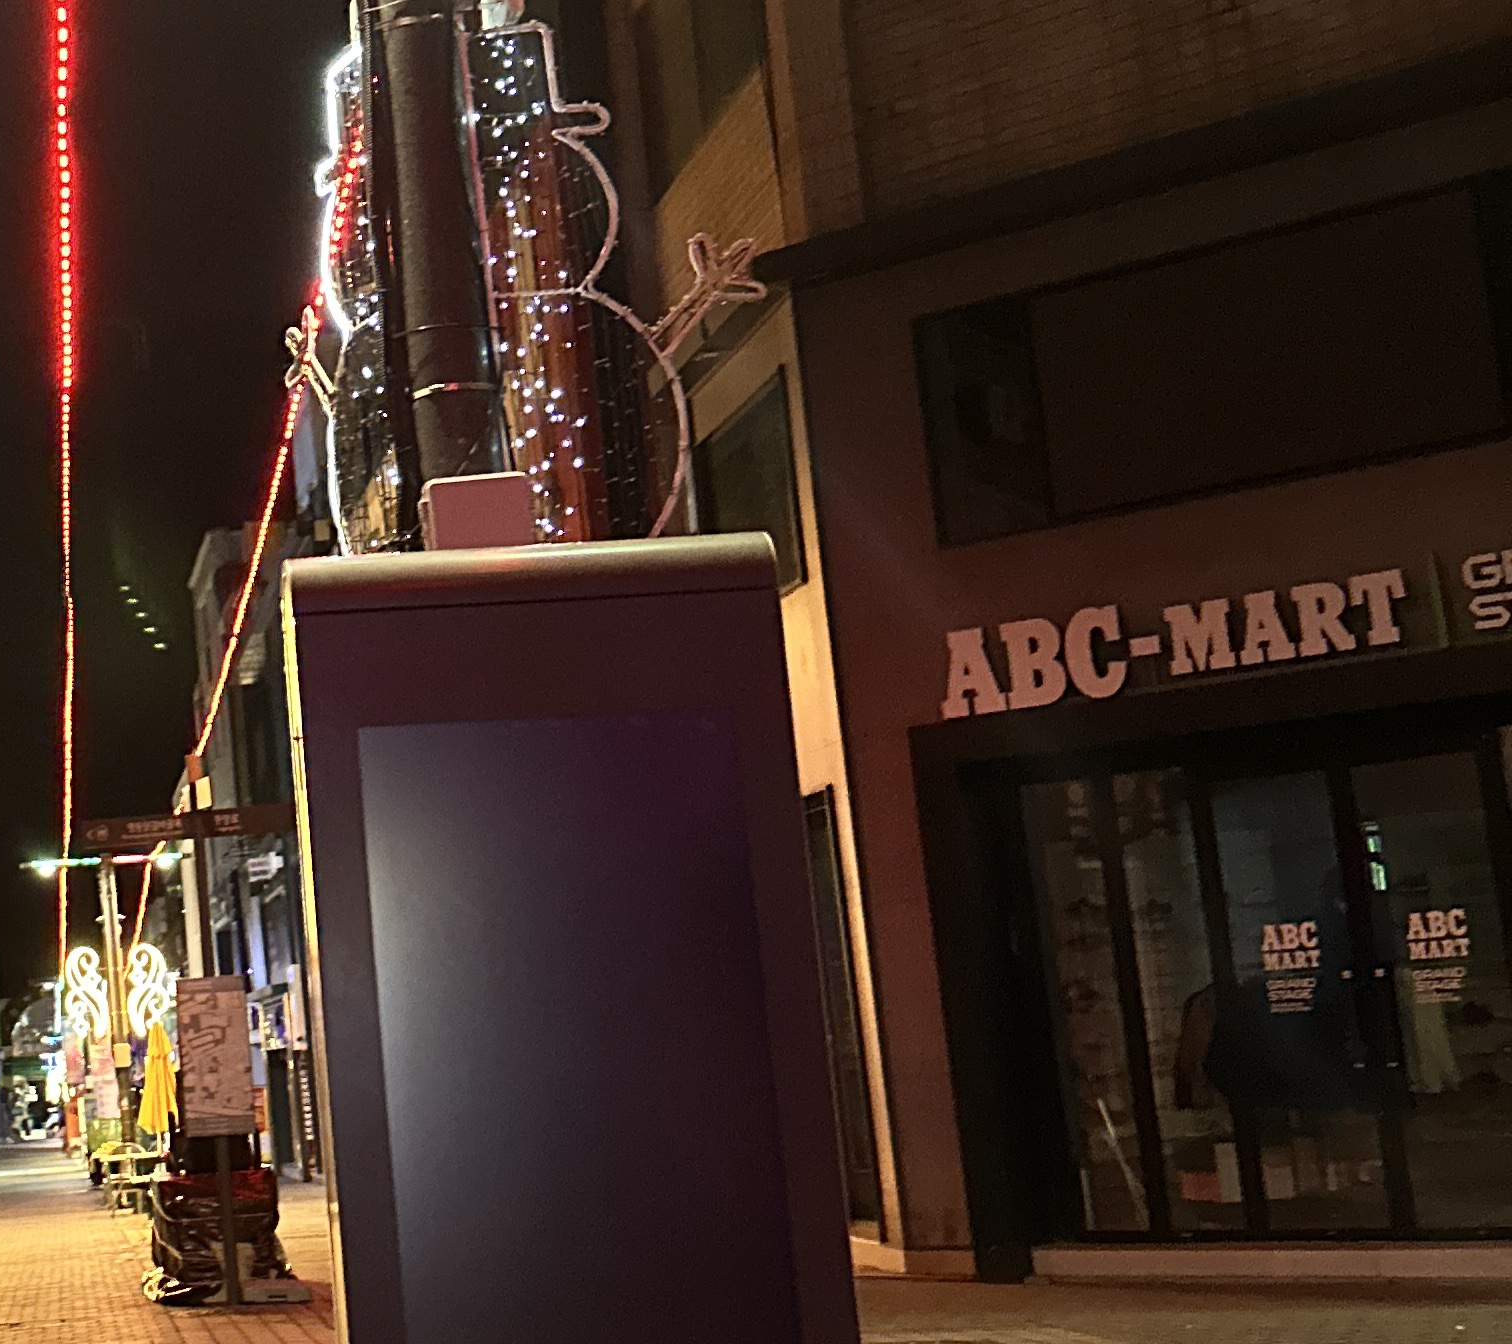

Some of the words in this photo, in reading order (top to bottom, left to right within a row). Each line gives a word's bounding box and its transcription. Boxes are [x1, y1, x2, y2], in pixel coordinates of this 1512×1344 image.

[940, 567, 1406, 720] ABC-MART
[1260, 921, 1319, 952] ABC
[1407, 908, 1468, 940] ABC
[1261, 948, 1320, 972] MART
[1407, 937, 1471, 961] MART
